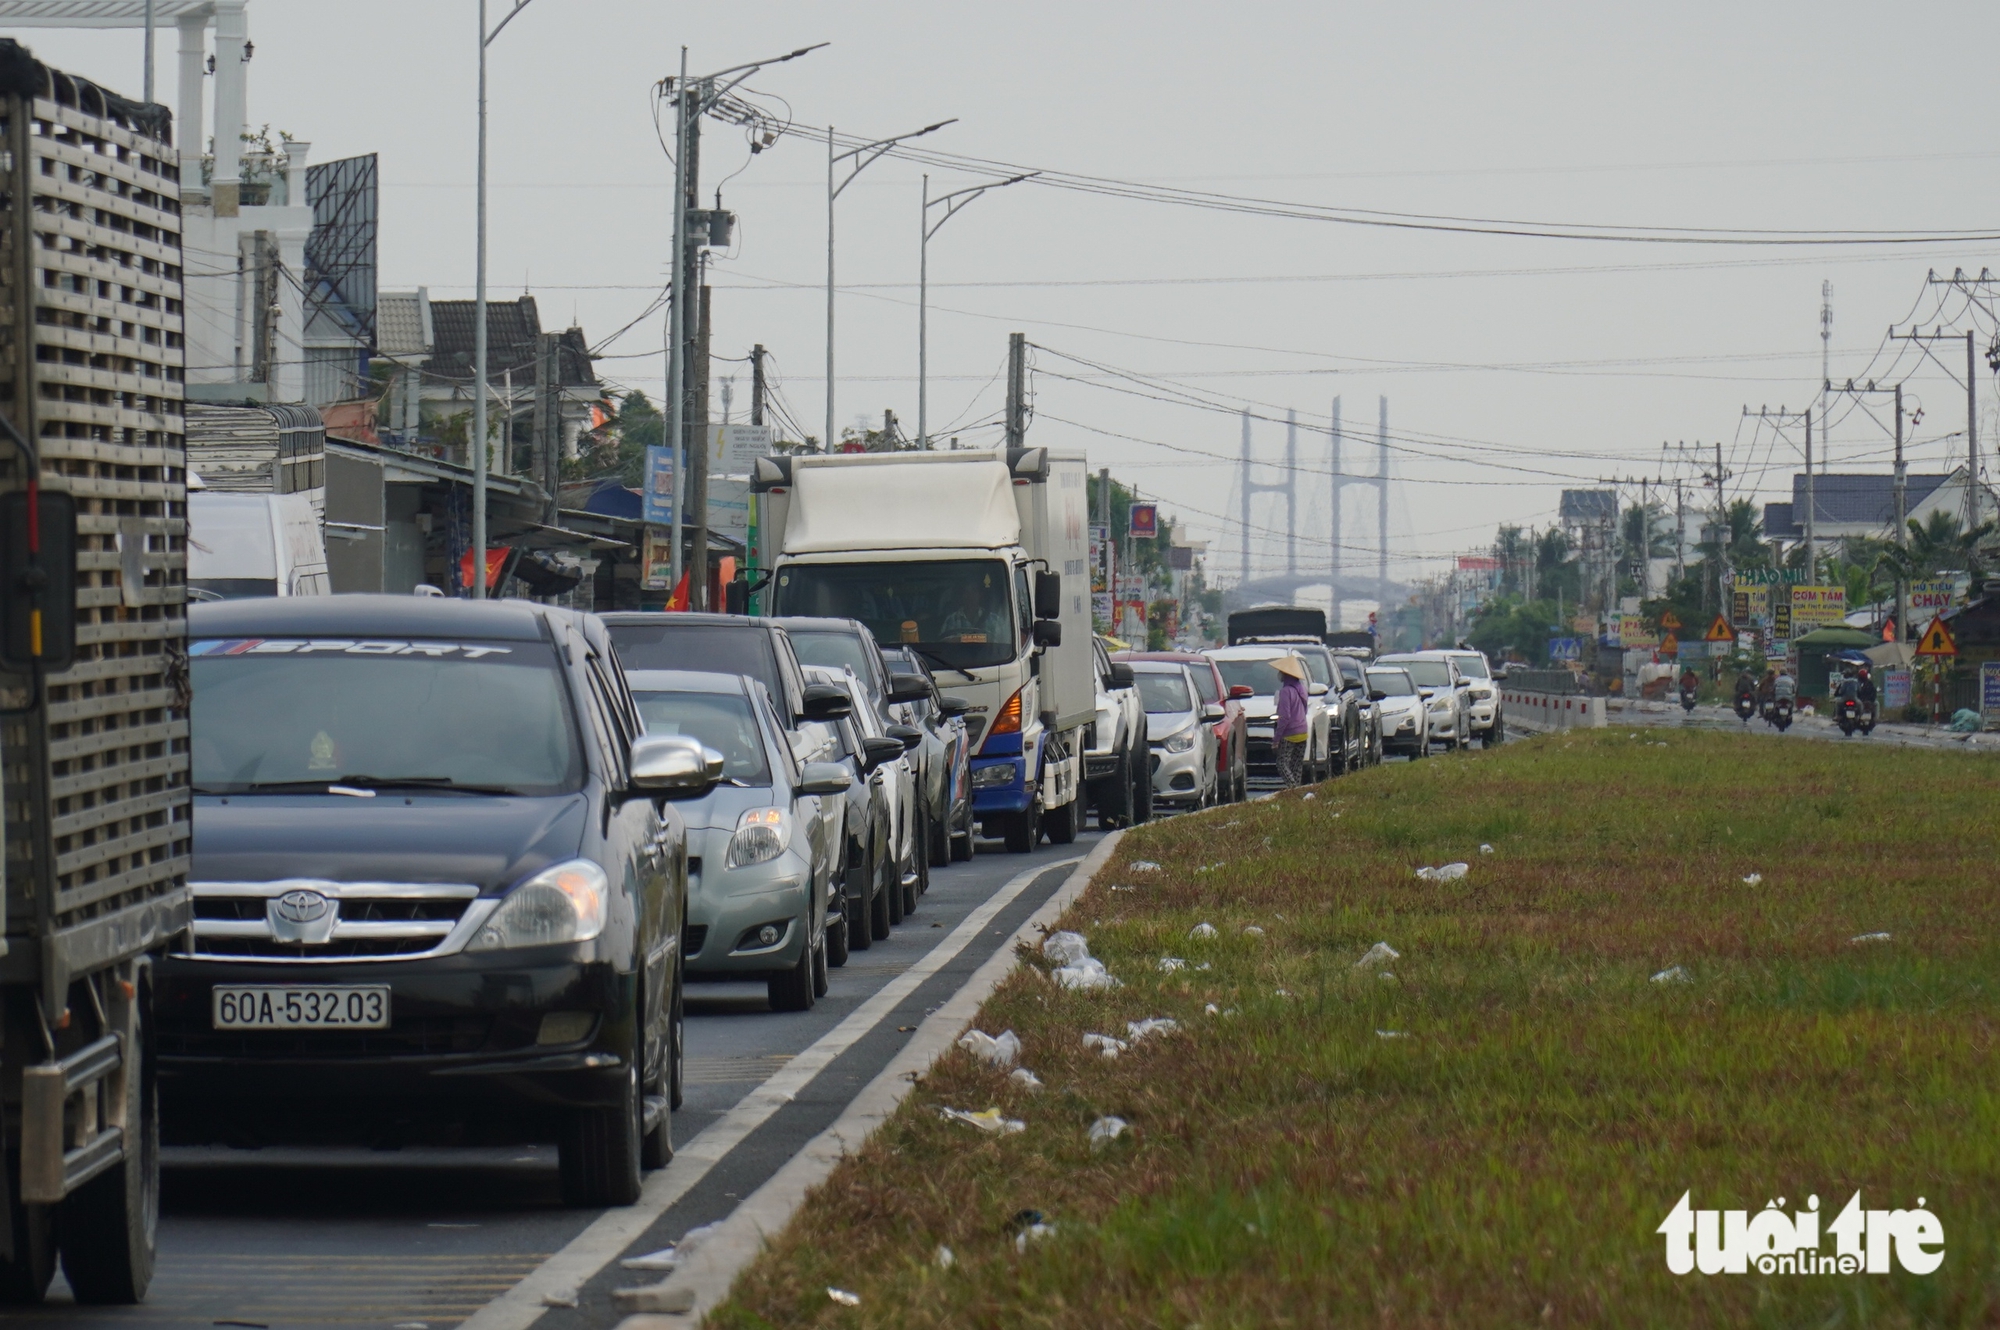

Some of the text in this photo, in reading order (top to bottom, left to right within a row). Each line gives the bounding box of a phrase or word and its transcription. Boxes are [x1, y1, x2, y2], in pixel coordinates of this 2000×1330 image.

[1912, 593, 1952, 607] CHAY
[246, 640, 512, 658] SPORT
[220, 992, 383, 1024] 60A-532.03
